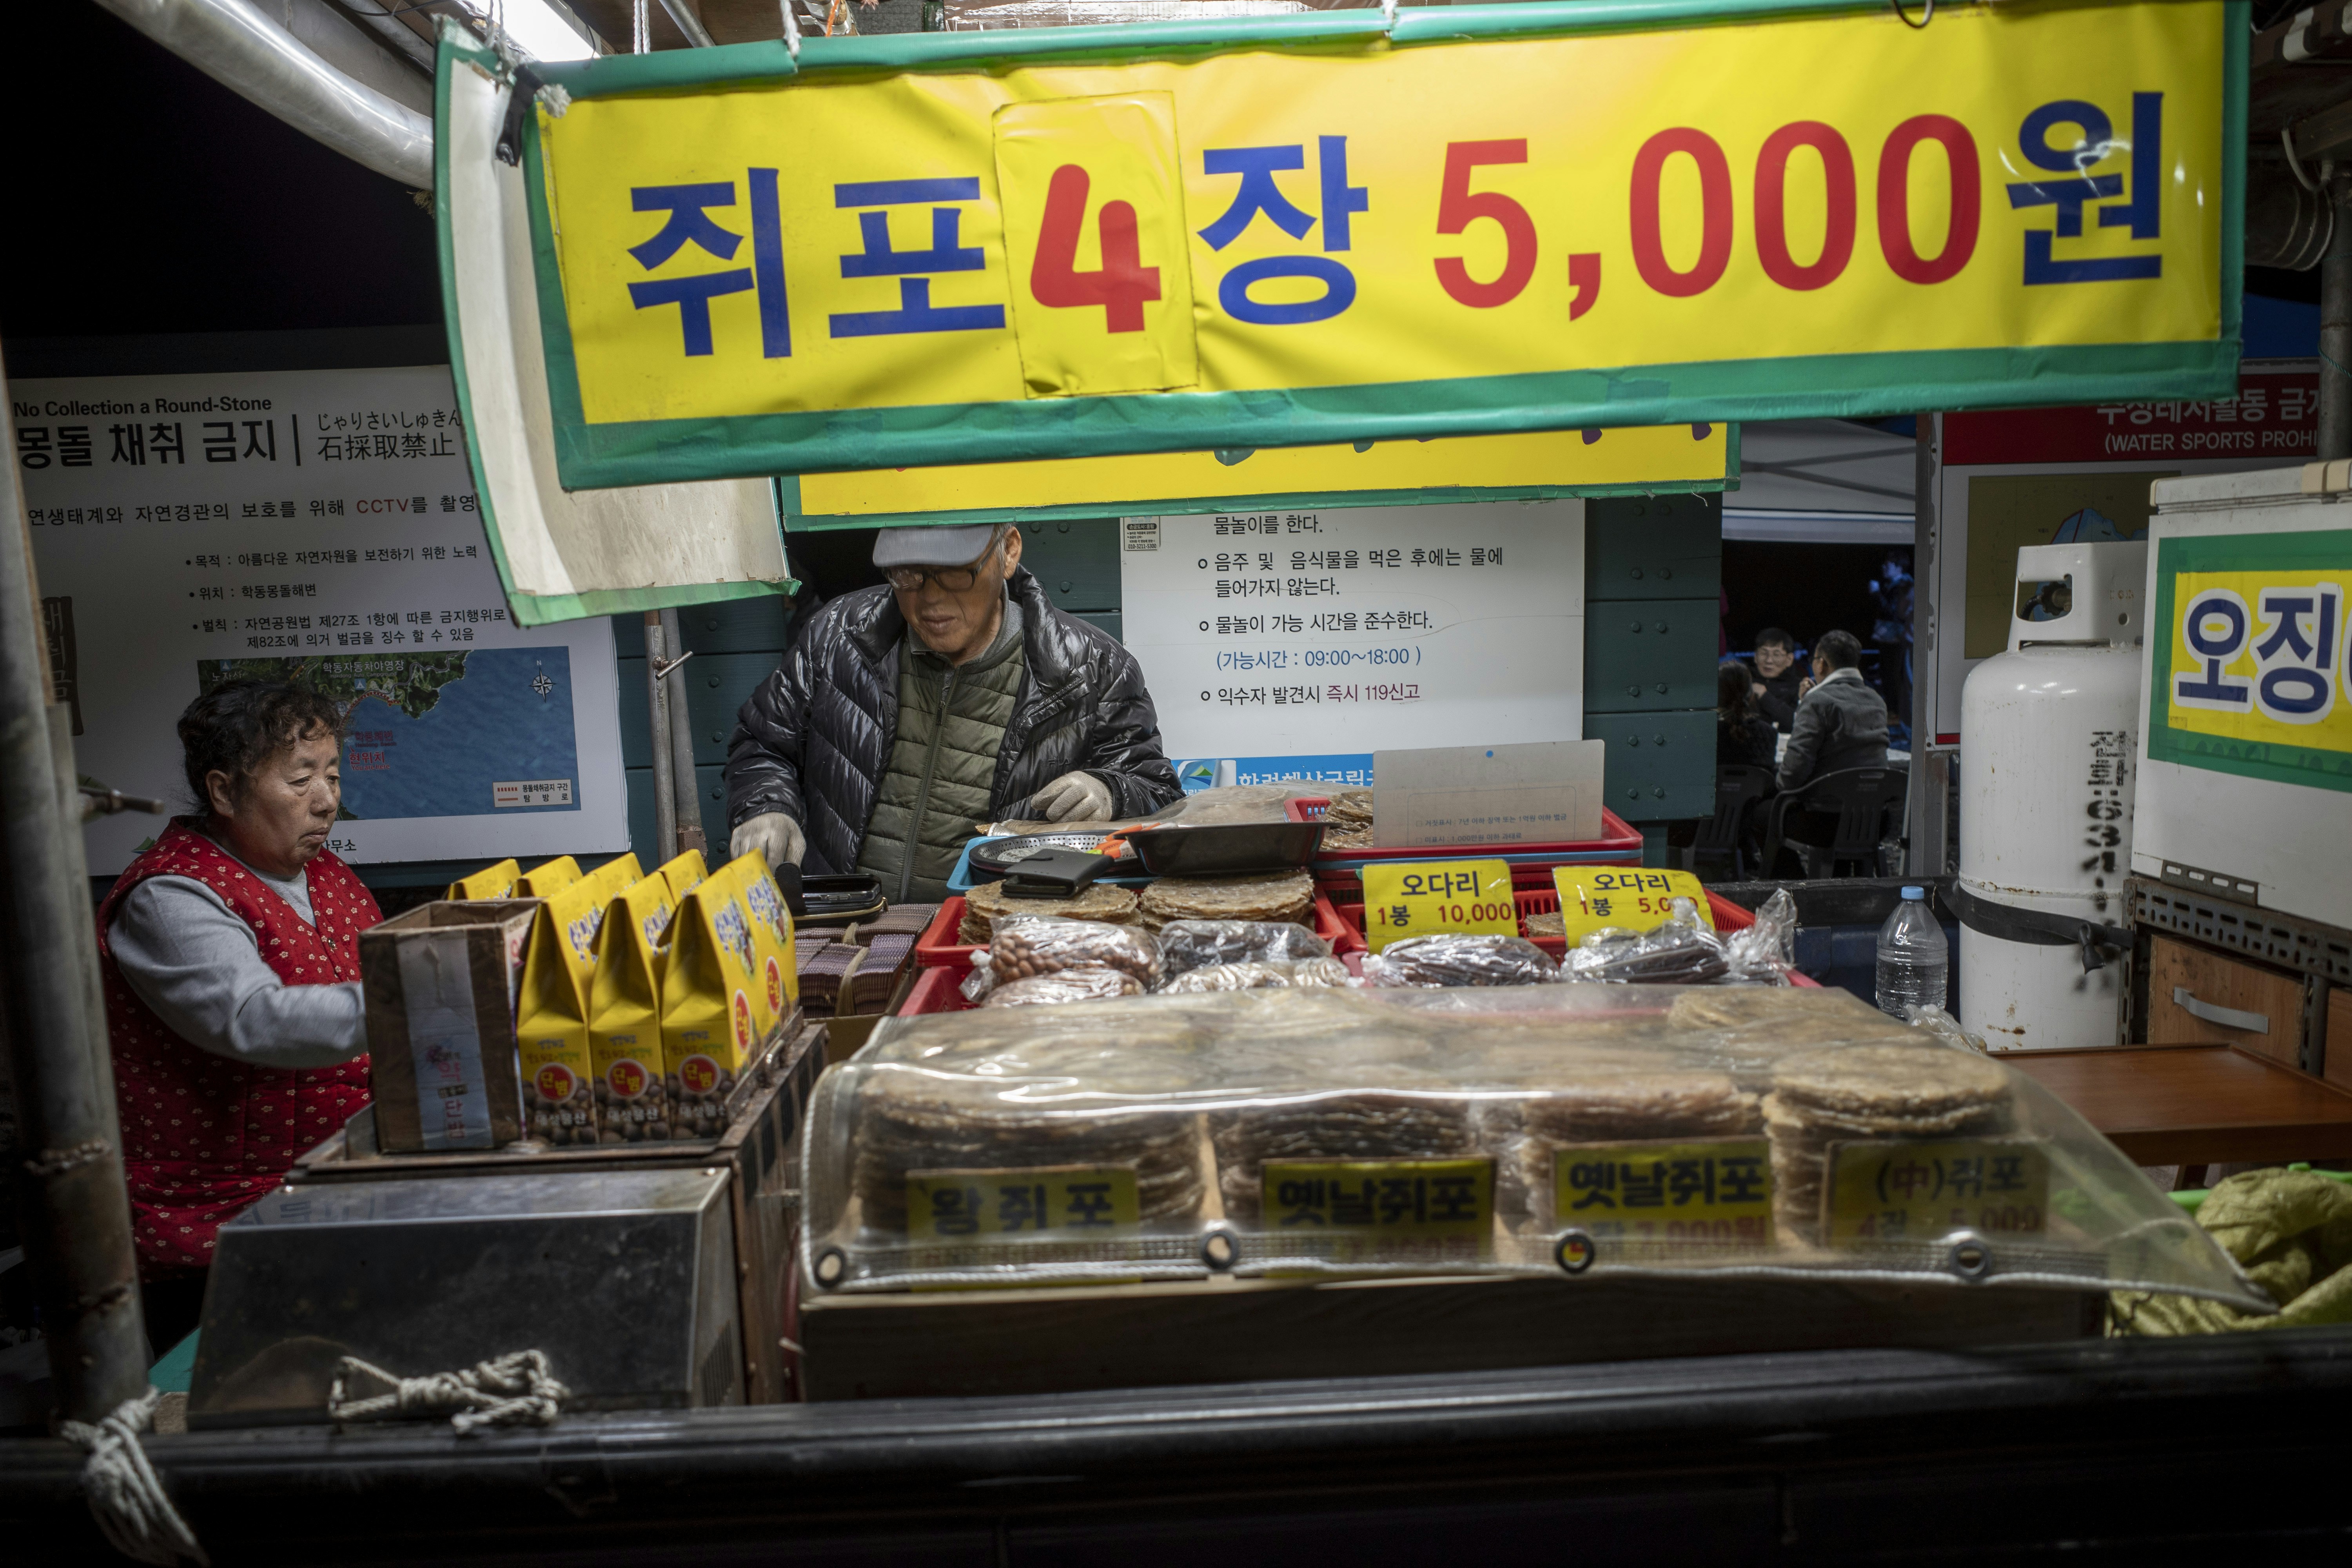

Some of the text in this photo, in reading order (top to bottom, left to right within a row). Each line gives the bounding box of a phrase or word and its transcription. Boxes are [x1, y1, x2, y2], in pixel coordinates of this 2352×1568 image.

[1432, 90, 2163, 321] 5,000원
[14, 396, 272, 417] No Collection a Round-Stone
[17, 419, 276, 469] 몽돌 채취 금지
[318, 432, 456, 461] 石採取禁止
[2105, 432, 2174, 454] (WATER
[2181, 432, 2254, 450] SPORTS
[135, 502, 229, 523] 자연경관의
[242, 500, 296, 518] 보호를
[309, 499, 344, 516] 위해
[356, 496, 428, 514] CCTV를
[439, 494, 475, 513] 촬영
[1213, 514, 1323, 535] 물놀이를 한다.
[195, 555, 220, 568] 목적
[238, 553, 288, 567] 아름다운
[295, 550, 358, 565] 자연자원을
[365, 547, 414, 562] 보전하기
[421, 546, 446, 560] 위한
[453, 545, 477, 559] 노력
[1214, 546, 1503, 572] 음주 및 음식물을 먹은 후에는 물에
[199, 586, 224, 601] 위치
[241, 583, 317, 599] 학동몽돌해변
[1215, 576, 1340, 598] 들어가지 않는다.
[202, 618, 227, 633] 벌칙
[245, 615, 311, 631] 자연공원법
[319, 613, 359, 628] 제27조
[367, 612, 399, 626] 1항에
[407, 611, 432, 624] 따른
[439, 608, 506, 624] 금지행위로
[1216, 610, 1433, 634] 물놀이 가능 시간을 준수한다.
[247, 627, 474, 649] 제82조에 의거 벌금을 징수 할 수 있음
[1217, 649, 1287, 671] (가능시간
[2178, 592, 2352, 714] 오징
[323, 659, 405, 673] 학동자동차야영장
[1218, 682, 1420, 706] 익수자 발견시 즉시 119신고
[349, 751, 385, 765] 현위치
[522, 782, 568, 792] 몽돌채취금지 구간
[1553, 813, 1567, 821] 벌금
[1425, 835, 1445, 844] 미표시
[1451, 833, 1485, 843] 1,000만원
[1401, 870, 1480, 899] 오다리
[1593, 873, 1671, 892] 오다리
[1377, 900, 1512, 927] 1봉 10,000
[1580, 897, 1613, 917] 1봉
[540, 1071, 569, 1097] 단밤
[612, 1067, 641, 1093] 단밤
[684, 1063, 713, 1088] 단밤
[1570, 1156, 1765, 1210] 옛날쥐포
[1279, 1175, 1478, 1226] 옛날쥐포
